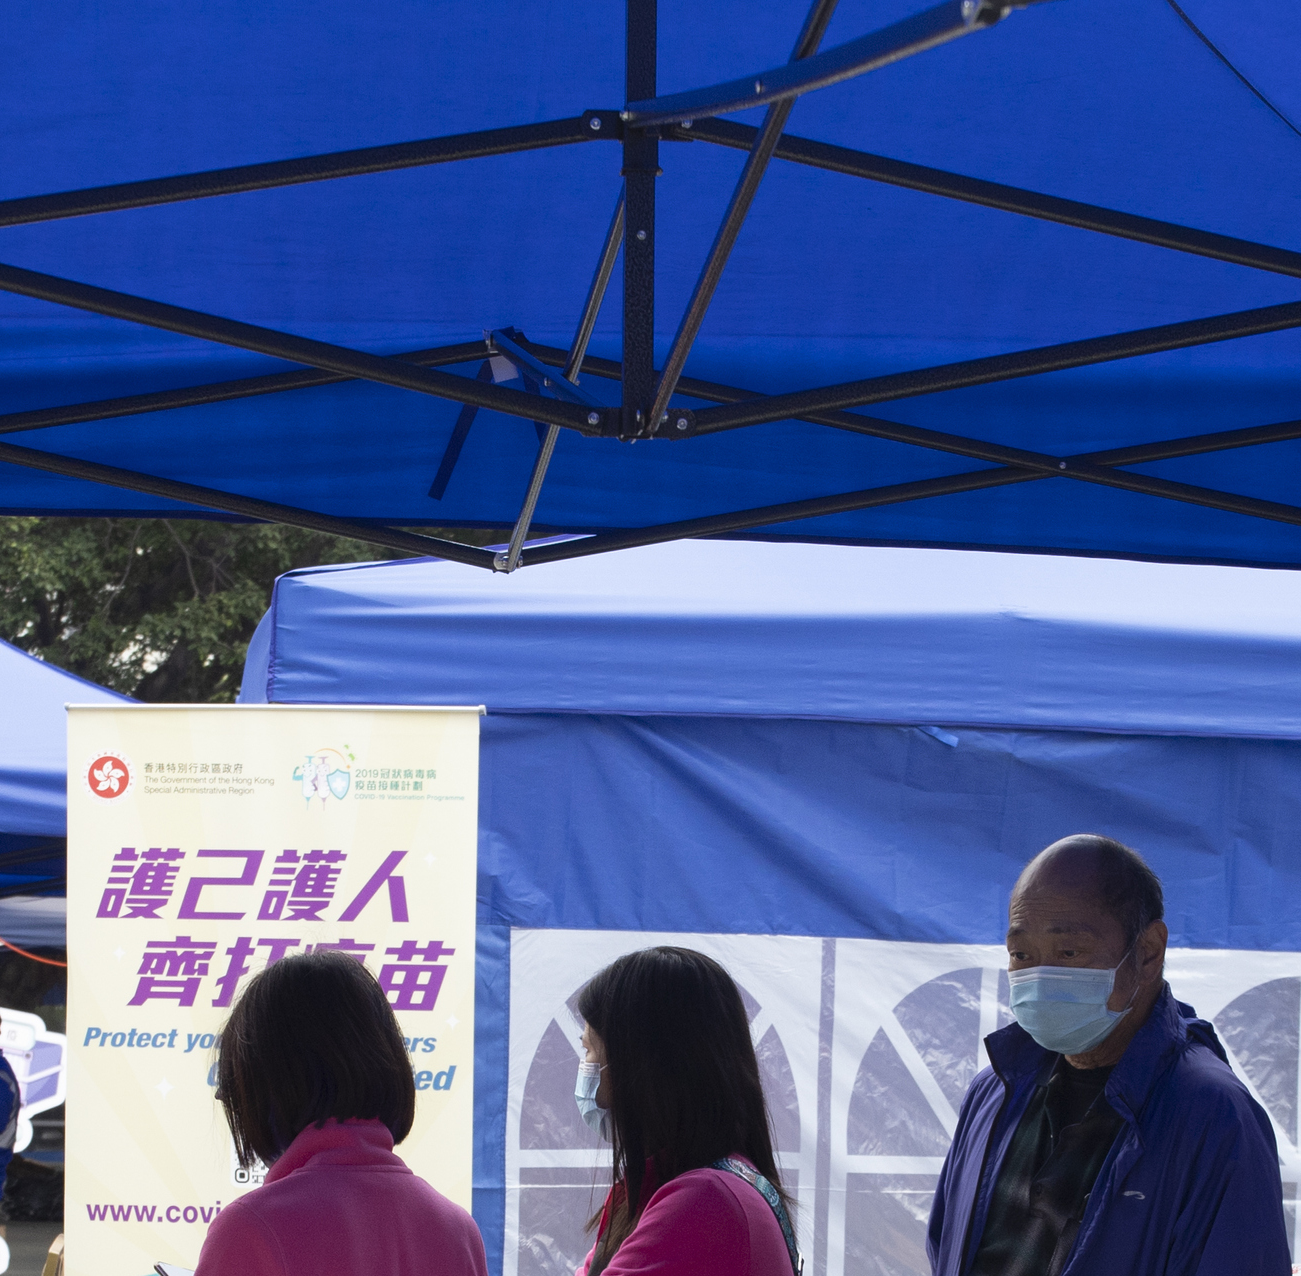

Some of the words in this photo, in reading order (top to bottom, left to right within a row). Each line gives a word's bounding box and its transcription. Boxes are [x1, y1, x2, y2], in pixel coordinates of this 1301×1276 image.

[144, 763, 243, 774] 香港特別行政區政府
[144, 776, 158, 784] The
[160, 776, 207, 784] Government
[209, 776, 217, 784] of
[232, 777, 252, 786] Hong
[254, 777, 275, 786] Kong
[144, 786, 172, 795] Special
[173, 786, 227, 794] Administrative
[228, 787, 255, 796] Region
[96, 847, 412, 923] 護己護人
[83, 1027, 178, 1048] Protect
